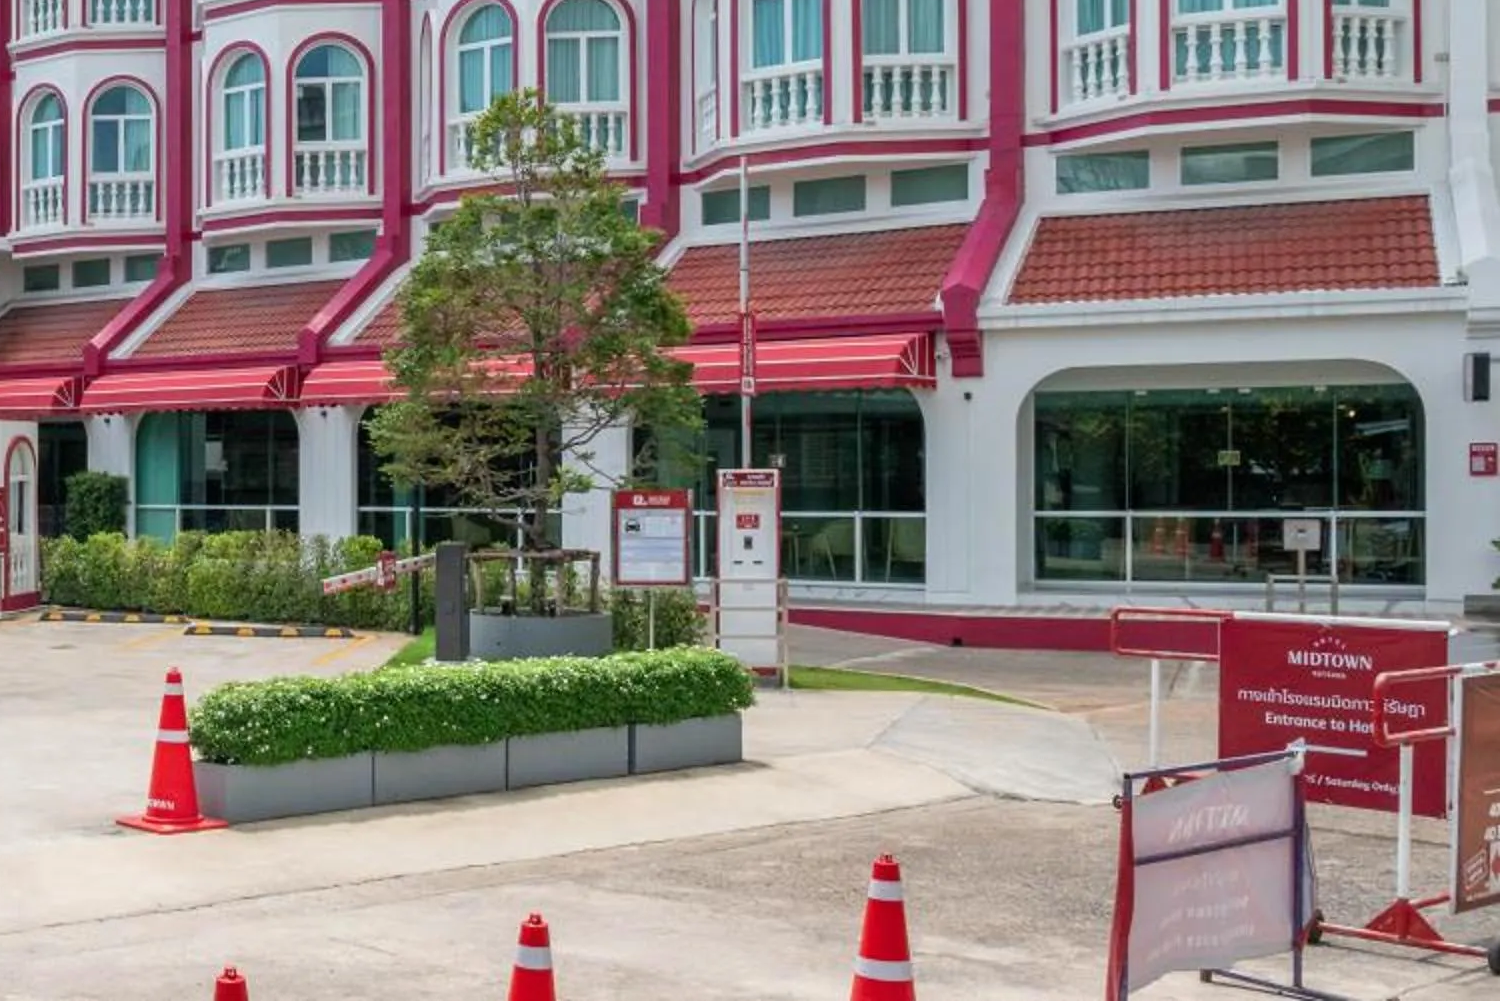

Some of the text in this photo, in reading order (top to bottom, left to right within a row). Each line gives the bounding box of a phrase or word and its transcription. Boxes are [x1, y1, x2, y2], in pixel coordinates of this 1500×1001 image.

[1287, 650, 1373, 670] MIDTOWN
[1265, 711, 1327, 730] Entrance
[1331, 718, 1346, 732] to
